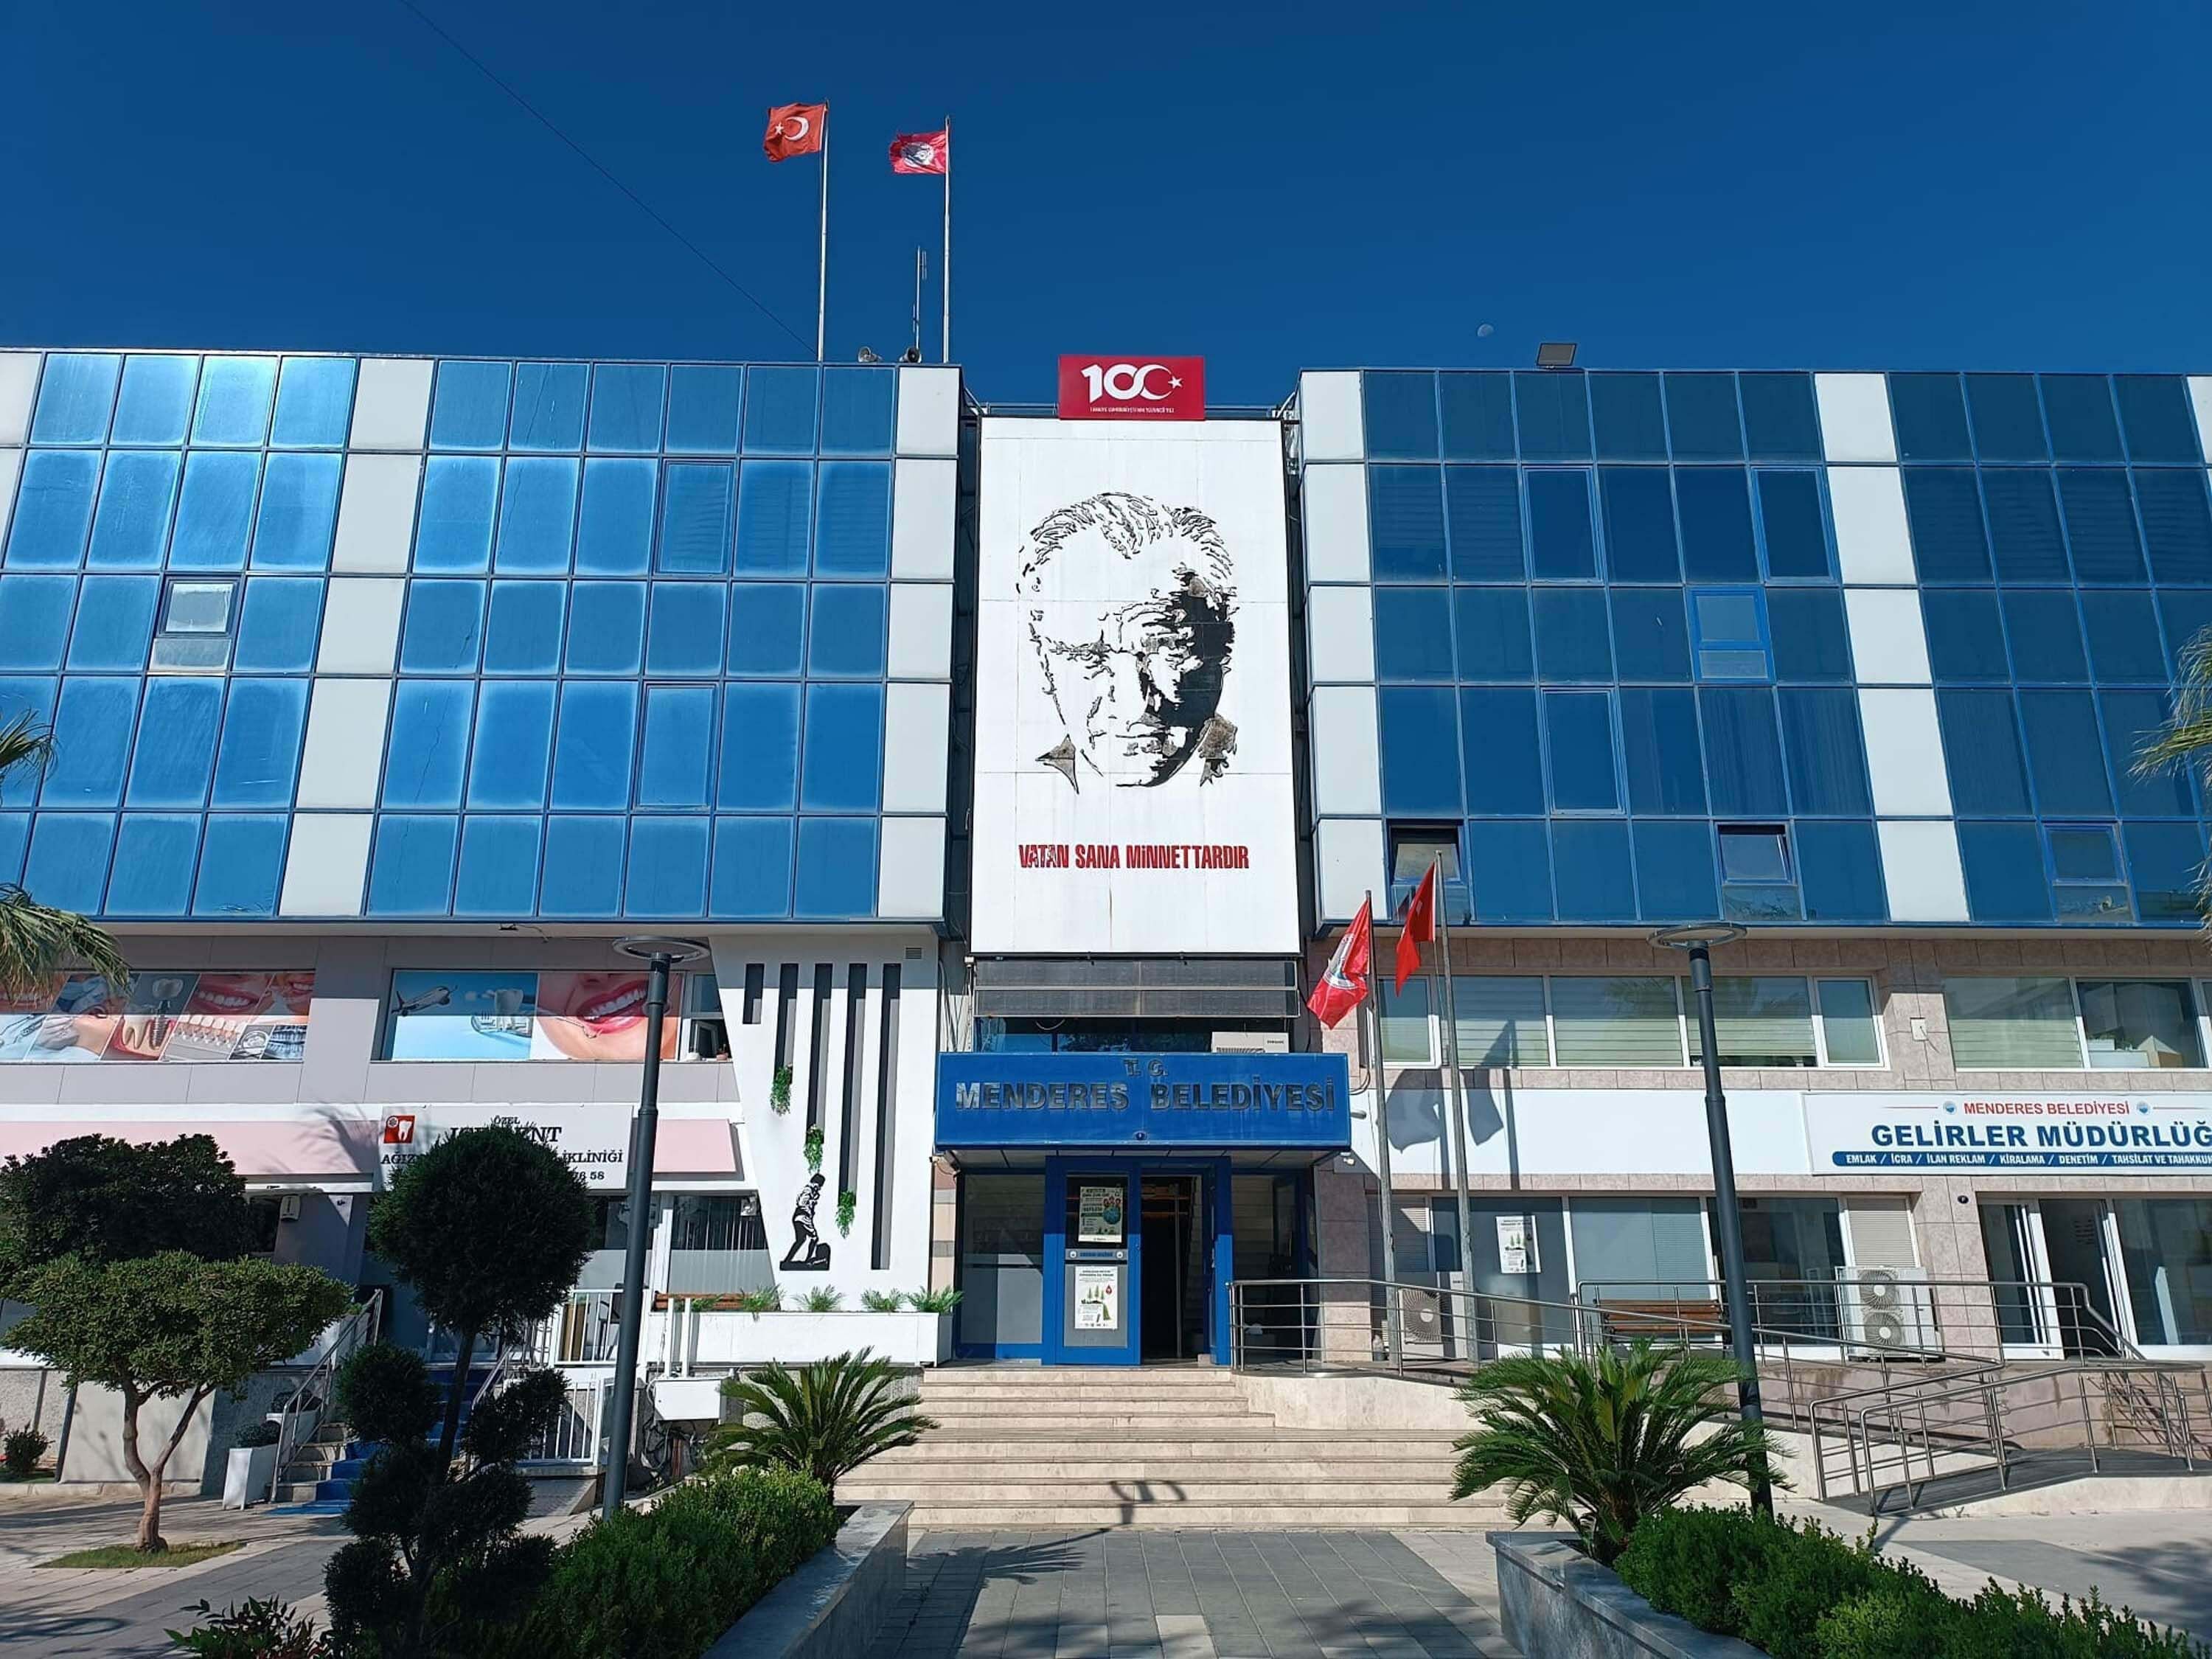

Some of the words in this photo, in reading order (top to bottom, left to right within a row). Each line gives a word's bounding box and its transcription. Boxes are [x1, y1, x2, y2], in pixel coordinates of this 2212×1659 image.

[1018, 844, 1069, 868] VATAN
[1075, 844, 1120, 869] SANA
[1126, 845, 1249, 869] MİNNETTARDIR
[956, 1081, 1130, 1110] MENDERES
[1150, 1075, 1335, 1111] BELEDİYESİ
[1964, 1103, 2043, 1115] MENDERES
[2047, 1101, 2130, 1115] BELEDİYESİ
[1871, 1121, 2028, 1147] GELİRLER
[2037, 1121, 2212, 1147] MÜDÜRLÜĞ
[380, 1151, 414, 1164] AĞIZ
[1846, 1154, 1877, 1164] EMLAK
[1891, 1153, 1913, 1164] İCRA
[1927, 1153, 1947, 1164] İLAN
[1949, 1154, 1986, 1164] REKLAM
[2000, 1153, 2045, 1164] KİRALAMA
[2059, 1153, 2098, 1164] DENETİM
[2111, 1153, 2153, 1164] TAHSİLAT
[2154, 1155, 2166, 1164] VE
[590, 1171, 605, 1180] 58
